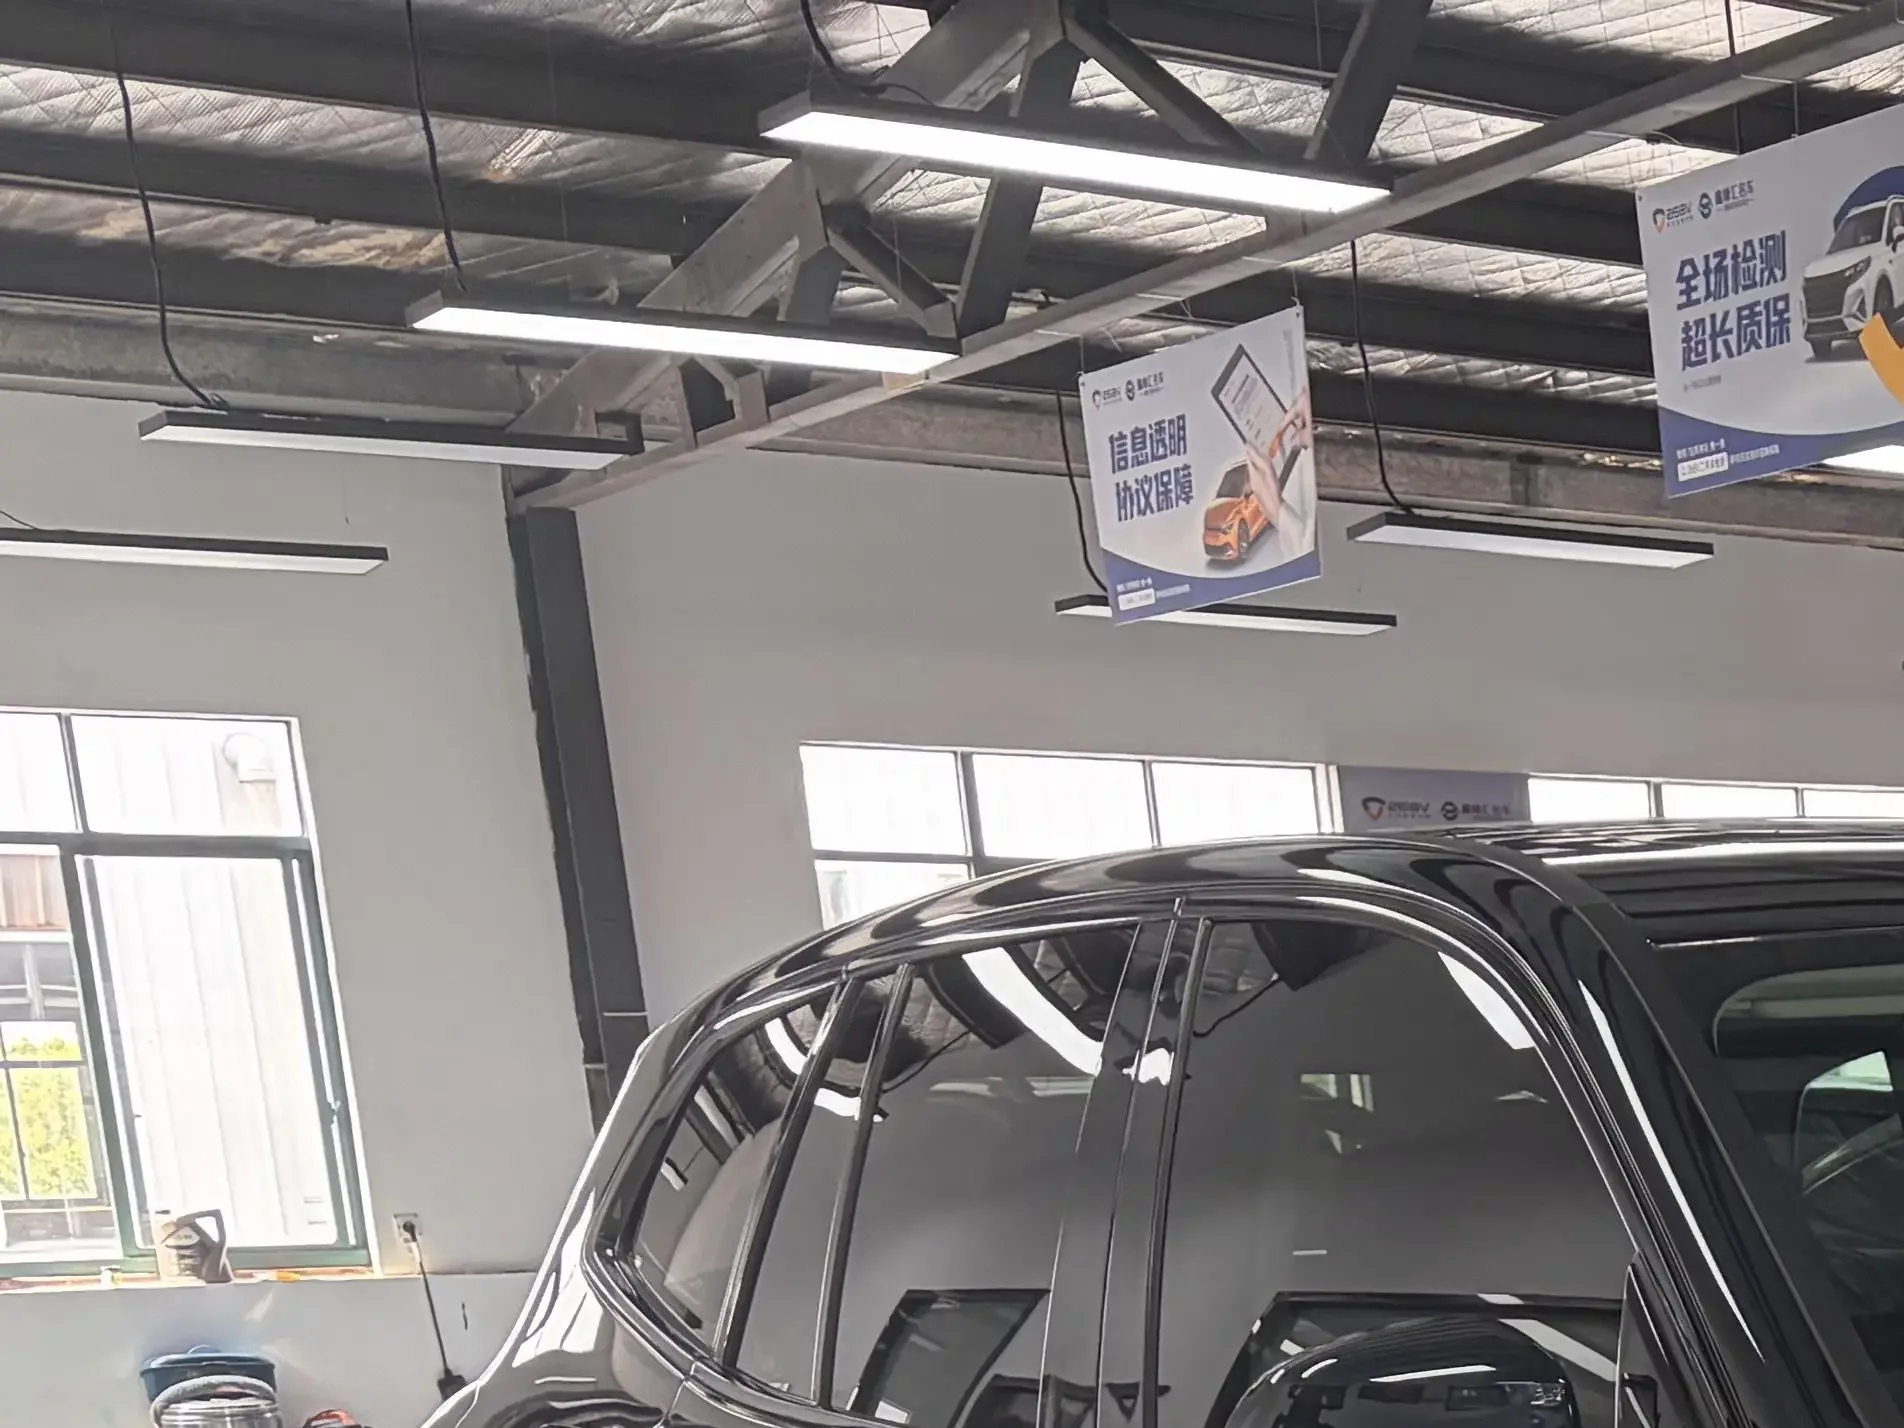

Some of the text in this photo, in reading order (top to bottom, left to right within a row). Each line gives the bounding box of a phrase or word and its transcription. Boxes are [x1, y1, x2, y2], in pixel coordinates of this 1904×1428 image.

[1675, 229, 1787, 311] 全场检测
[1681, 293, 1791, 372] 超长质保
[1108, 413, 1187, 474] 信息透明
[1115, 463, 1194, 522] 协议保障
